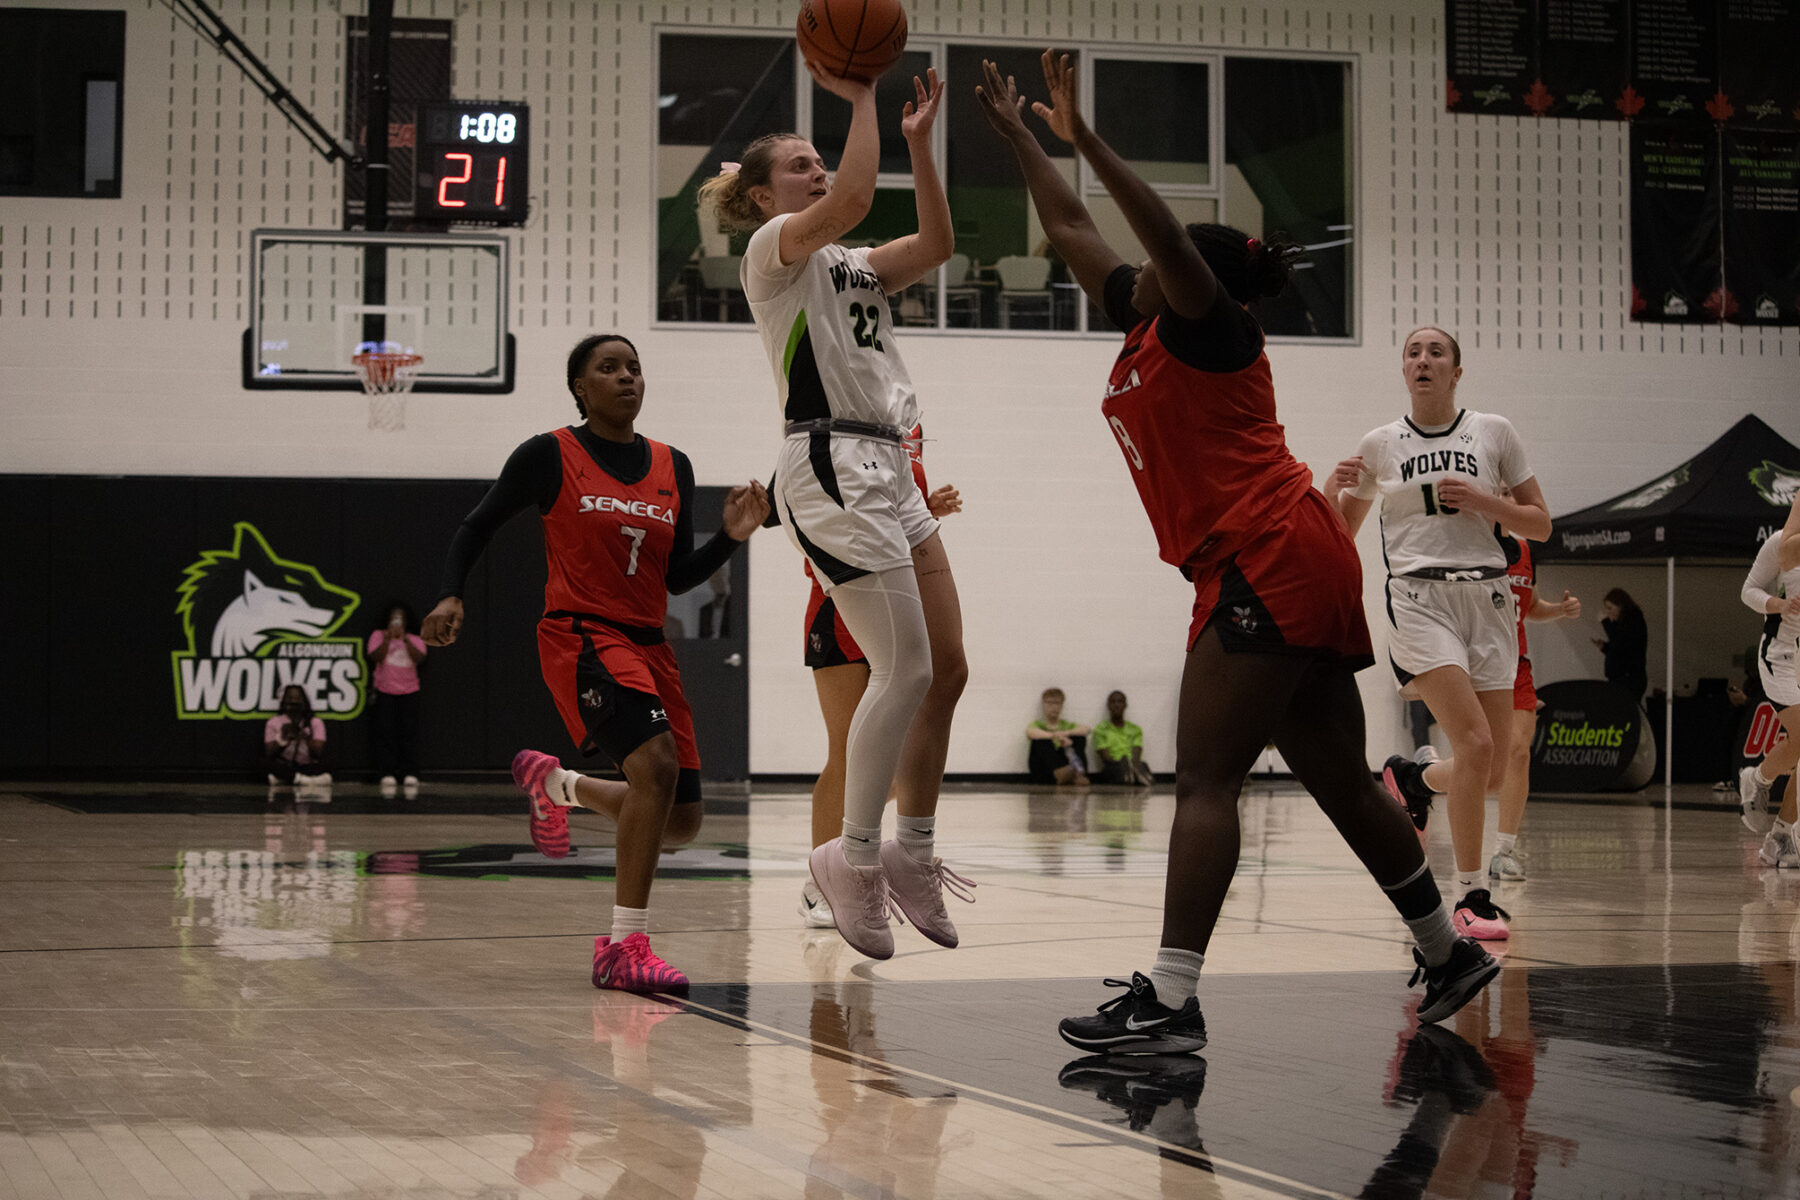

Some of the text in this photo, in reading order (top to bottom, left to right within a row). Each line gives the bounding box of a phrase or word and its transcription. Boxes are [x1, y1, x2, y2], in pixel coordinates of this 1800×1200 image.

[460, 112, 516, 144] 1:08
[438, 153, 507, 207] 21
[849, 302, 885, 353] 22
[1401, 450, 1478, 482] WOLVES
[579, 495, 674, 526] SENECA
[621, 526, 647, 576] 7
[1561, 529, 1631, 552] AlgonquinSA.com
[278, 643, 353, 657] ALGONQUIN
[181, 658, 360, 712] WOLVES
[1547, 720, 1631, 747] Students'
[1542, 748, 1620, 767] ASSOCIATION
